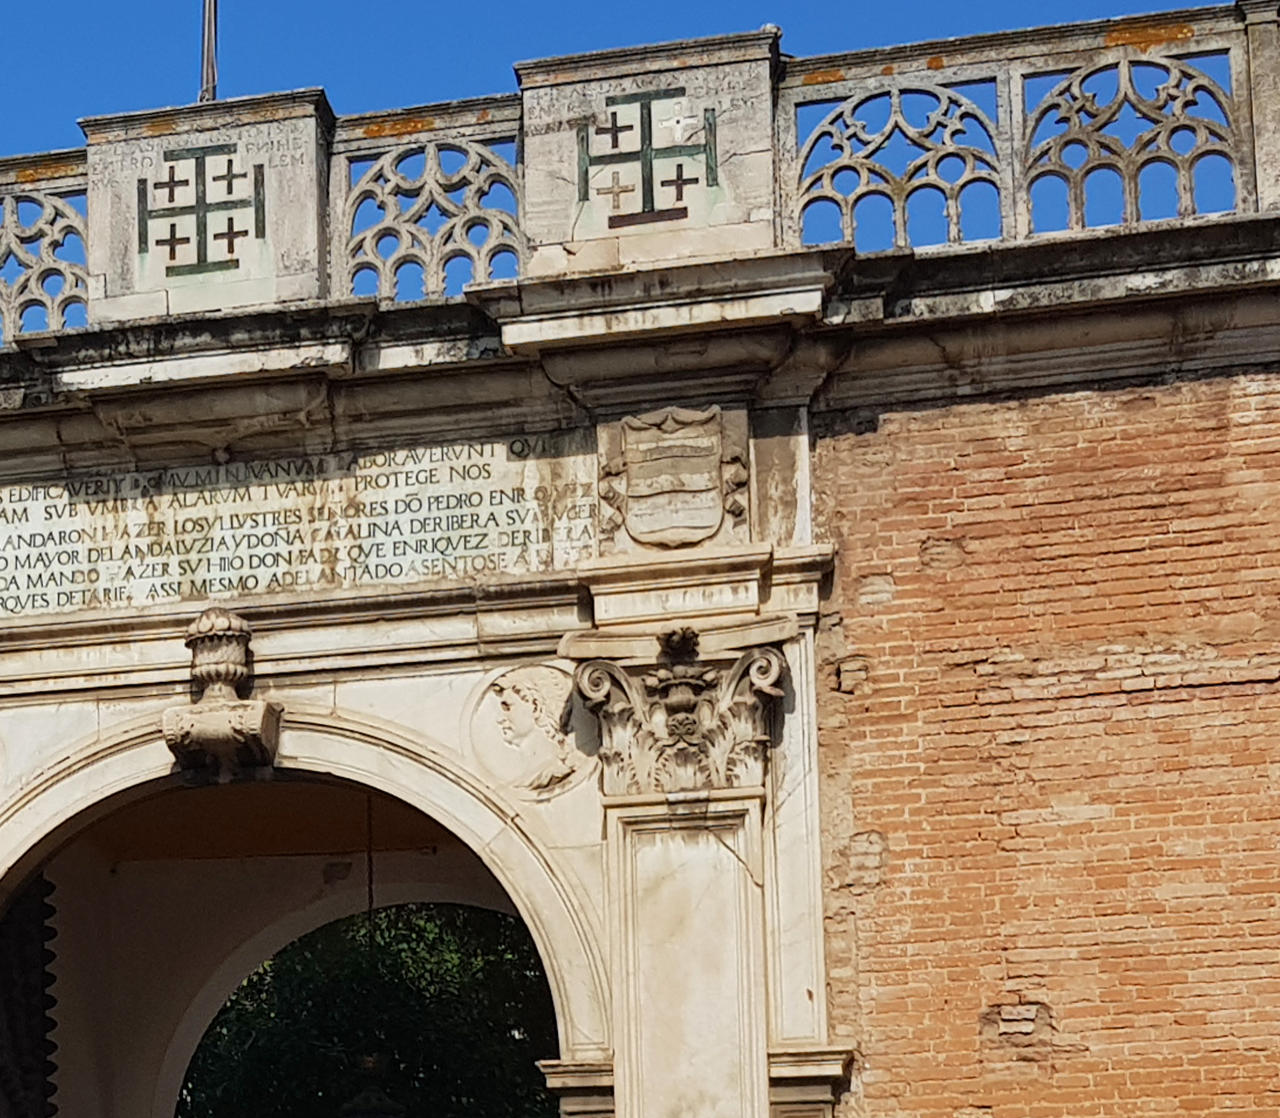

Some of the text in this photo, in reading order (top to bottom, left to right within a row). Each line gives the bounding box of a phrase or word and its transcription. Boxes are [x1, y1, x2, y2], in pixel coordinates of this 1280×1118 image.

[43, 502, 78, 520] SVB
[167, 486, 252, 507] ALARVM
[353, 469, 440, 489] PROTEGE
[449, 463, 491, 482] NOS
[427, 490, 483, 511] PEDRO
[14, 549, 82, 572] MAYOR
[26, 568, 100, 588] MANDO
[177, 557, 203, 575] SV
[249, 550, 292, 569] DON
[392, 533, 488, 559] ENRIQVEZ
[188, 575, 258, 593] MESMO
